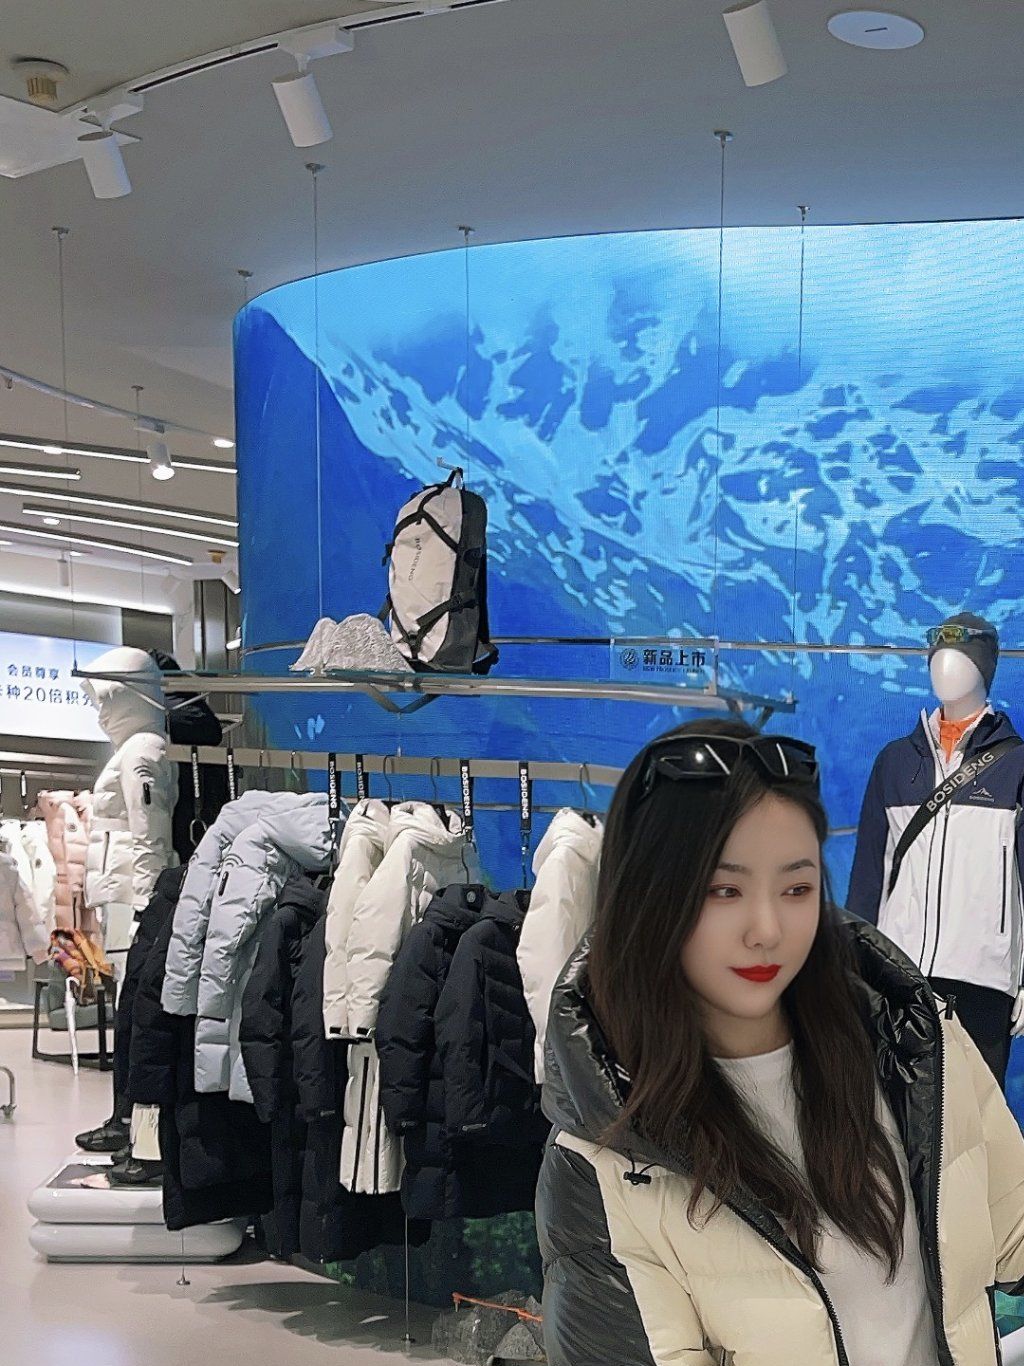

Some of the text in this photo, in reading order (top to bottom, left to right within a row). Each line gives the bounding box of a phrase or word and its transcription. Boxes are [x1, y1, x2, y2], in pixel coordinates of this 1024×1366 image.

[642, 648, 706, 668] 新品上市
[329, 760, 338, 809] BOSIDENG
[461, 765, 471, 817] BOSIDENG
[520, 768, 530, 820] BOSIDENG
[925, 751, 995, 813] BOSIDENG
